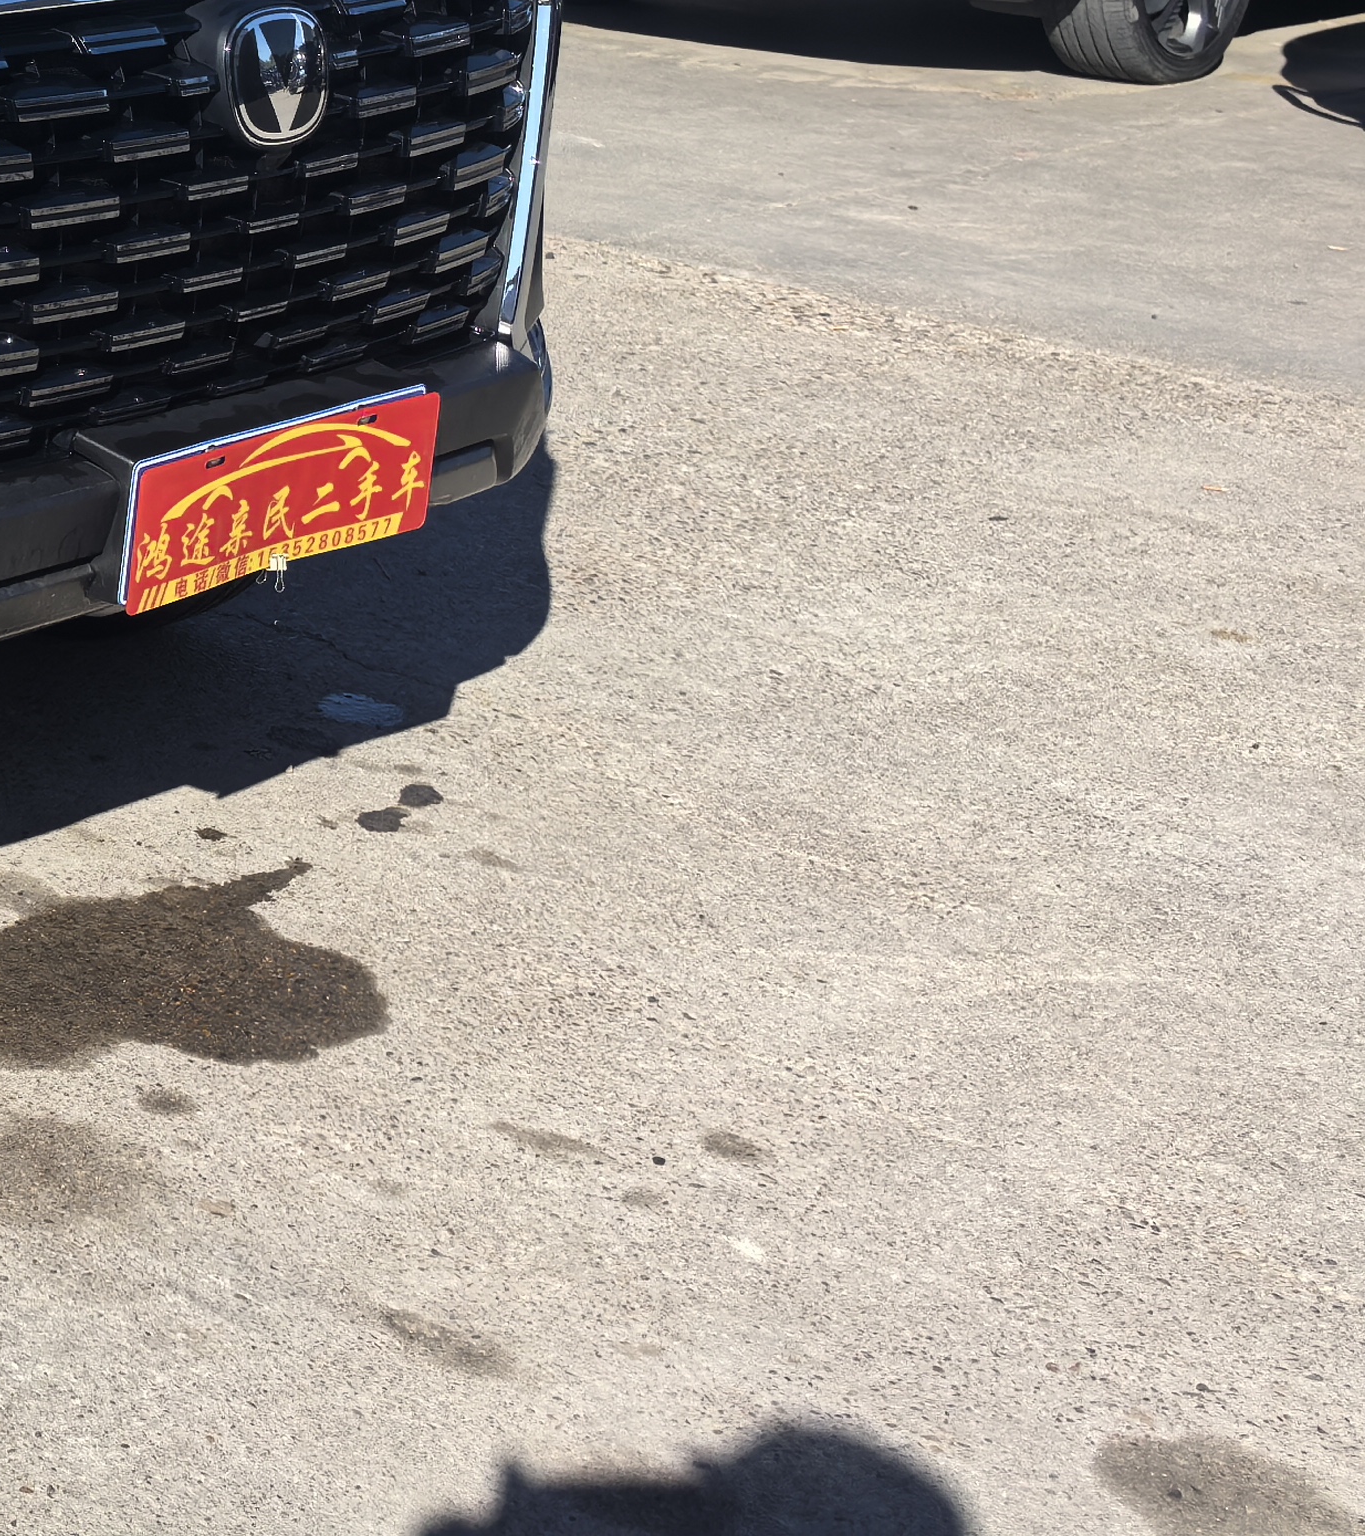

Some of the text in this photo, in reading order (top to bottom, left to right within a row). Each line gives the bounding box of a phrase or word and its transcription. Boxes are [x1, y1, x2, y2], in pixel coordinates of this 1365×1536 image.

[135, 451, 424, 583] 鸿途亲民二手车
